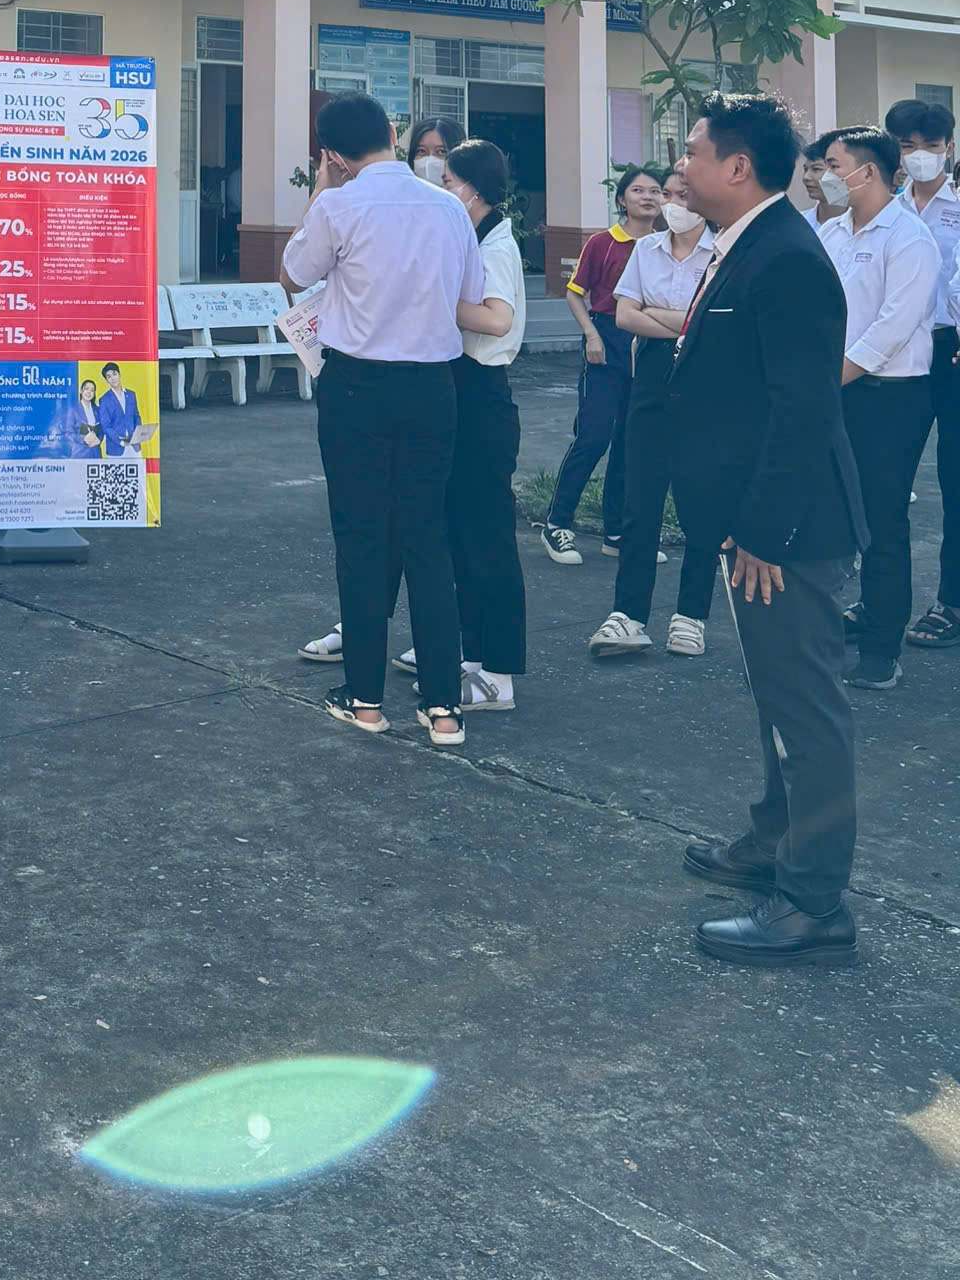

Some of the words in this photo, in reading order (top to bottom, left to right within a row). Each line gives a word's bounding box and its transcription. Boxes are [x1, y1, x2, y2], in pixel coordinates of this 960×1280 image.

[115, 71, 151, 85] HSU
[4, 108, 37, 121] HOA
[39, 110, 66, 122] SEN
[26, 147, 65, 160] SINH
[69, 145, 106, 161] NĂM
[110, 149, 148, 162] 2026
[6, 166, 51, 183] BỔNG
[55, 168, 98, 184] TOÀN
[103, 170, 147, 185] KHÓA
[0, 260, 34, 277] 25%
[6, 293, 37, 311] 15%
[5, 327, 35, 344] 15%
[42, 375, 66, 386] NĂM
[45, 465, 65, 473] SINH
